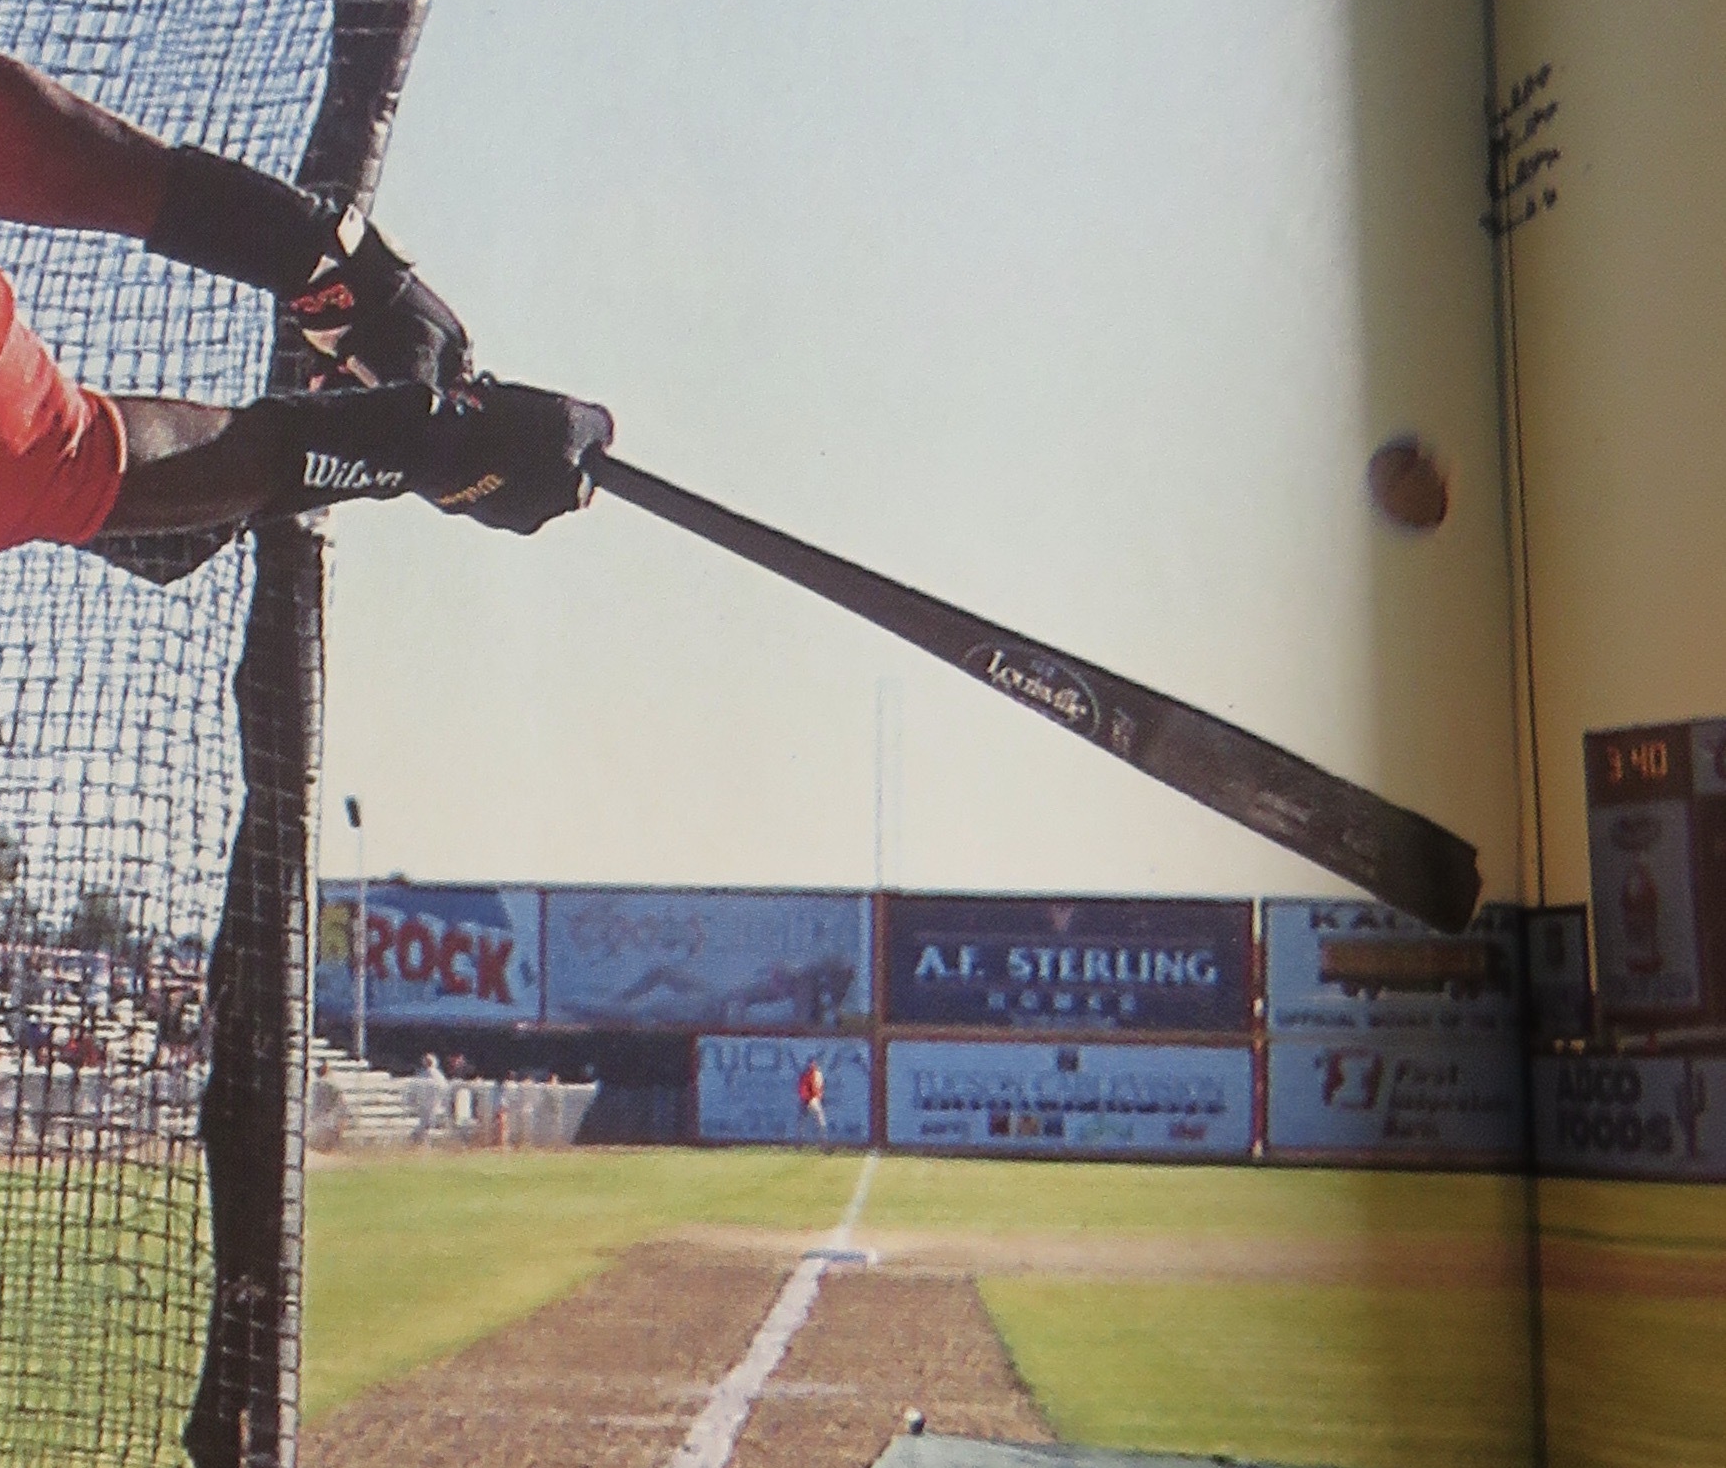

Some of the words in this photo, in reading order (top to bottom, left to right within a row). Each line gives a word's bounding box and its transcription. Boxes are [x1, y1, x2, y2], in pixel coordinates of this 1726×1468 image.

[304, 451, 404, 490] Wilson
[354, 911, 515, 1006] ROCK
[1007, 944, 1220, 987] STERLING
